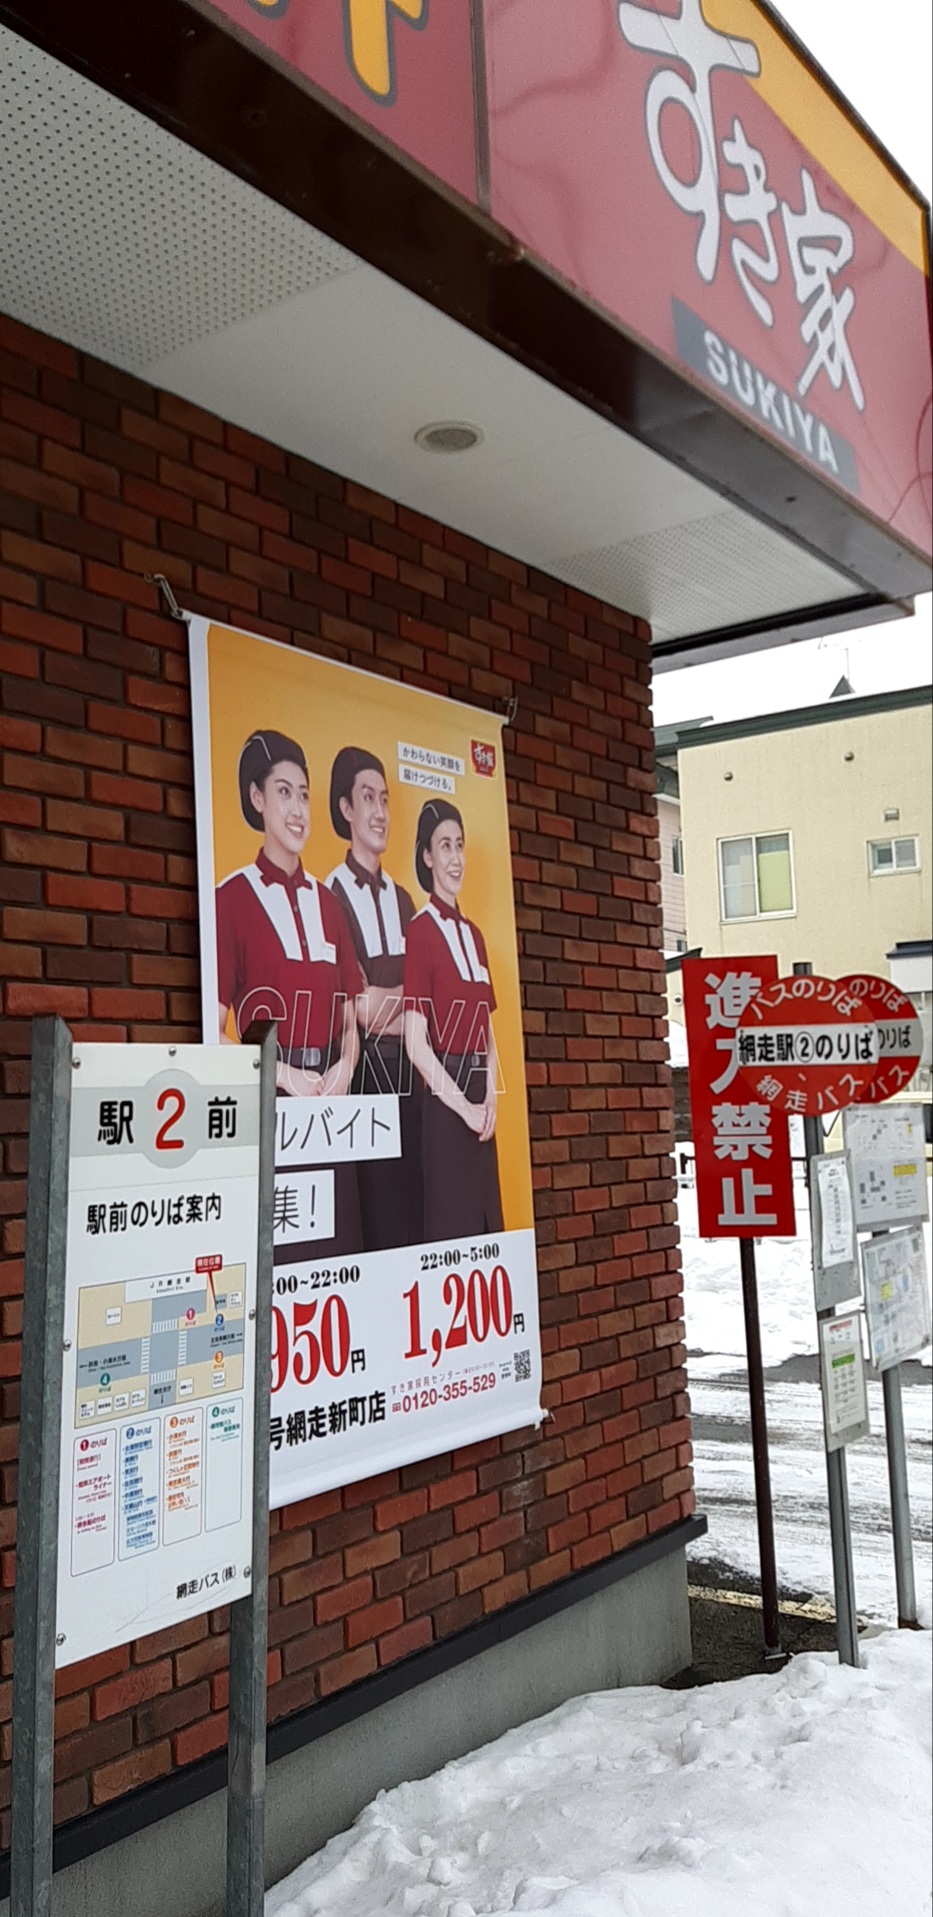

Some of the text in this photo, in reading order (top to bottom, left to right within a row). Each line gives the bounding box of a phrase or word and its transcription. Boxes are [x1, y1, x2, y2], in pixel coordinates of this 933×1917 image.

[617, 0, 865, 412] すき家
[703, 327, 841, 476] SUKIYA
[402, 746, 462, 773] かわらない笑顔を
[750, 977, 863, 1020] バスのりば
[86, 1191, 223, 1236] 駅前のりば案内
[402, 1371, 496, 1413] 0120-355-529
